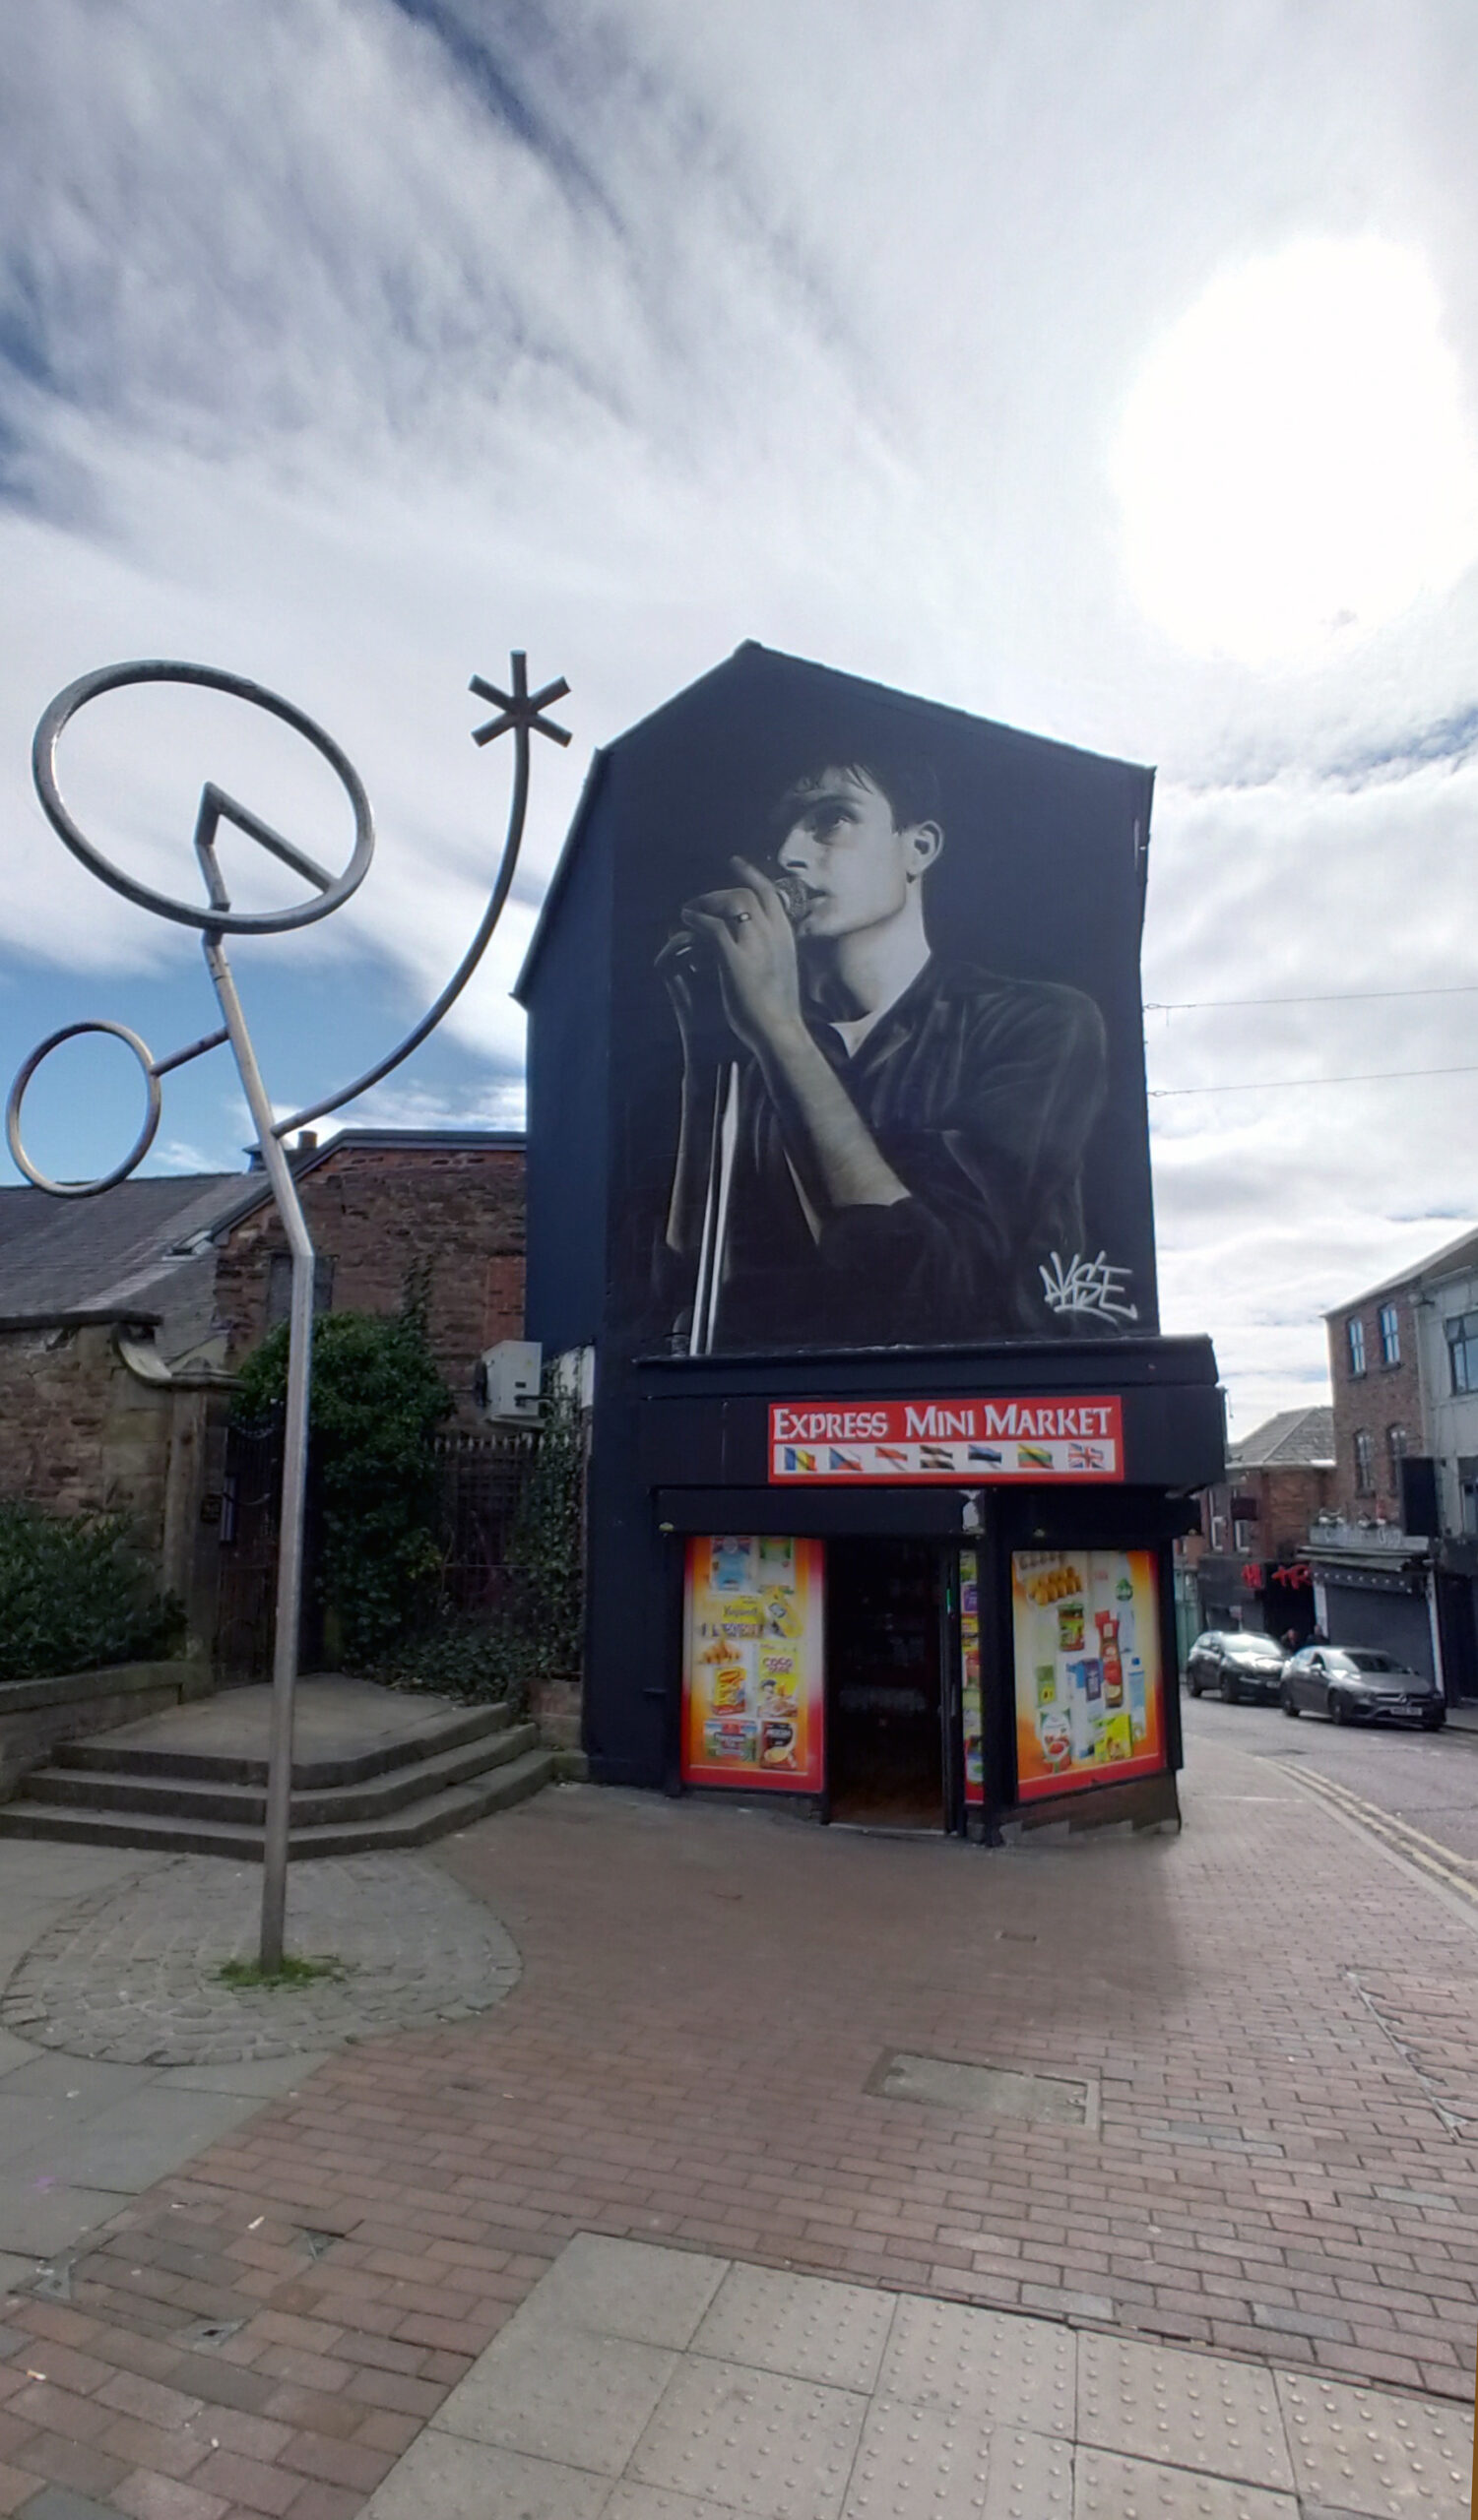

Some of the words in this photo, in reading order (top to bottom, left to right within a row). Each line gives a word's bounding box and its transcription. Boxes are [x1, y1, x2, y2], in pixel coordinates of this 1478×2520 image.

[773, 1408, 889, 1440] EXPRESS
[904, 1405, 974, 1437] MINI
[985, 1403, 1112, 1436] MARKET
